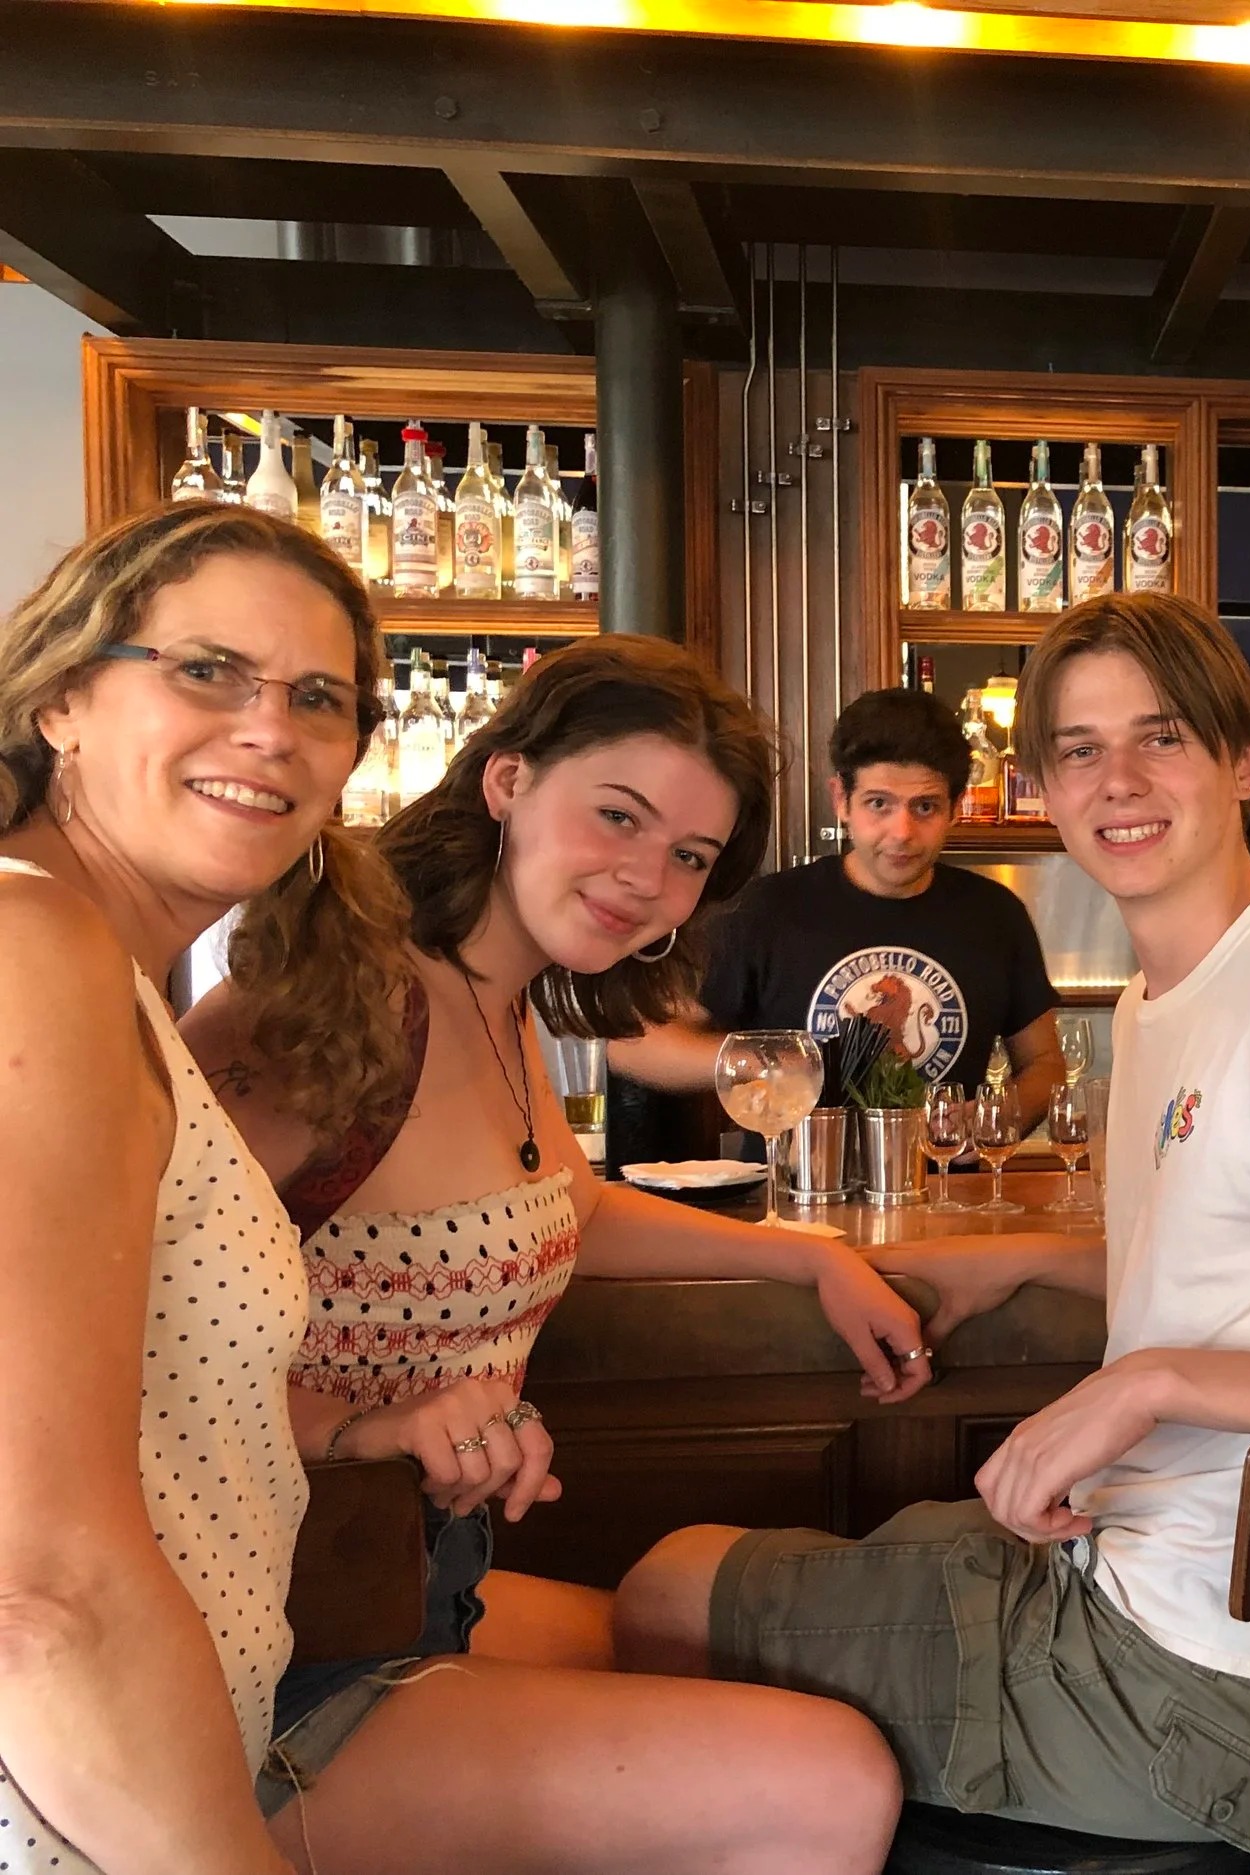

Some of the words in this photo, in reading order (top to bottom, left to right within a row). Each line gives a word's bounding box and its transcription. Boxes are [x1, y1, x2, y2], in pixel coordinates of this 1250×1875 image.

[913, 572, 945, 581] VODKA
[966, 575, 996, 583] VODKA
[1077, 575, 1108, 584] VODKA
[1027, 578, 1058, 586] VODKA
[1135, 580, 1166, 588] VODKA
[823, 951, 918, 1000] PORTOBELLO
[919, 966, 955, 1003] ROAD
[940, 1015, 960, 1034] 171
[925, 1049, 953, 1078] GIN
